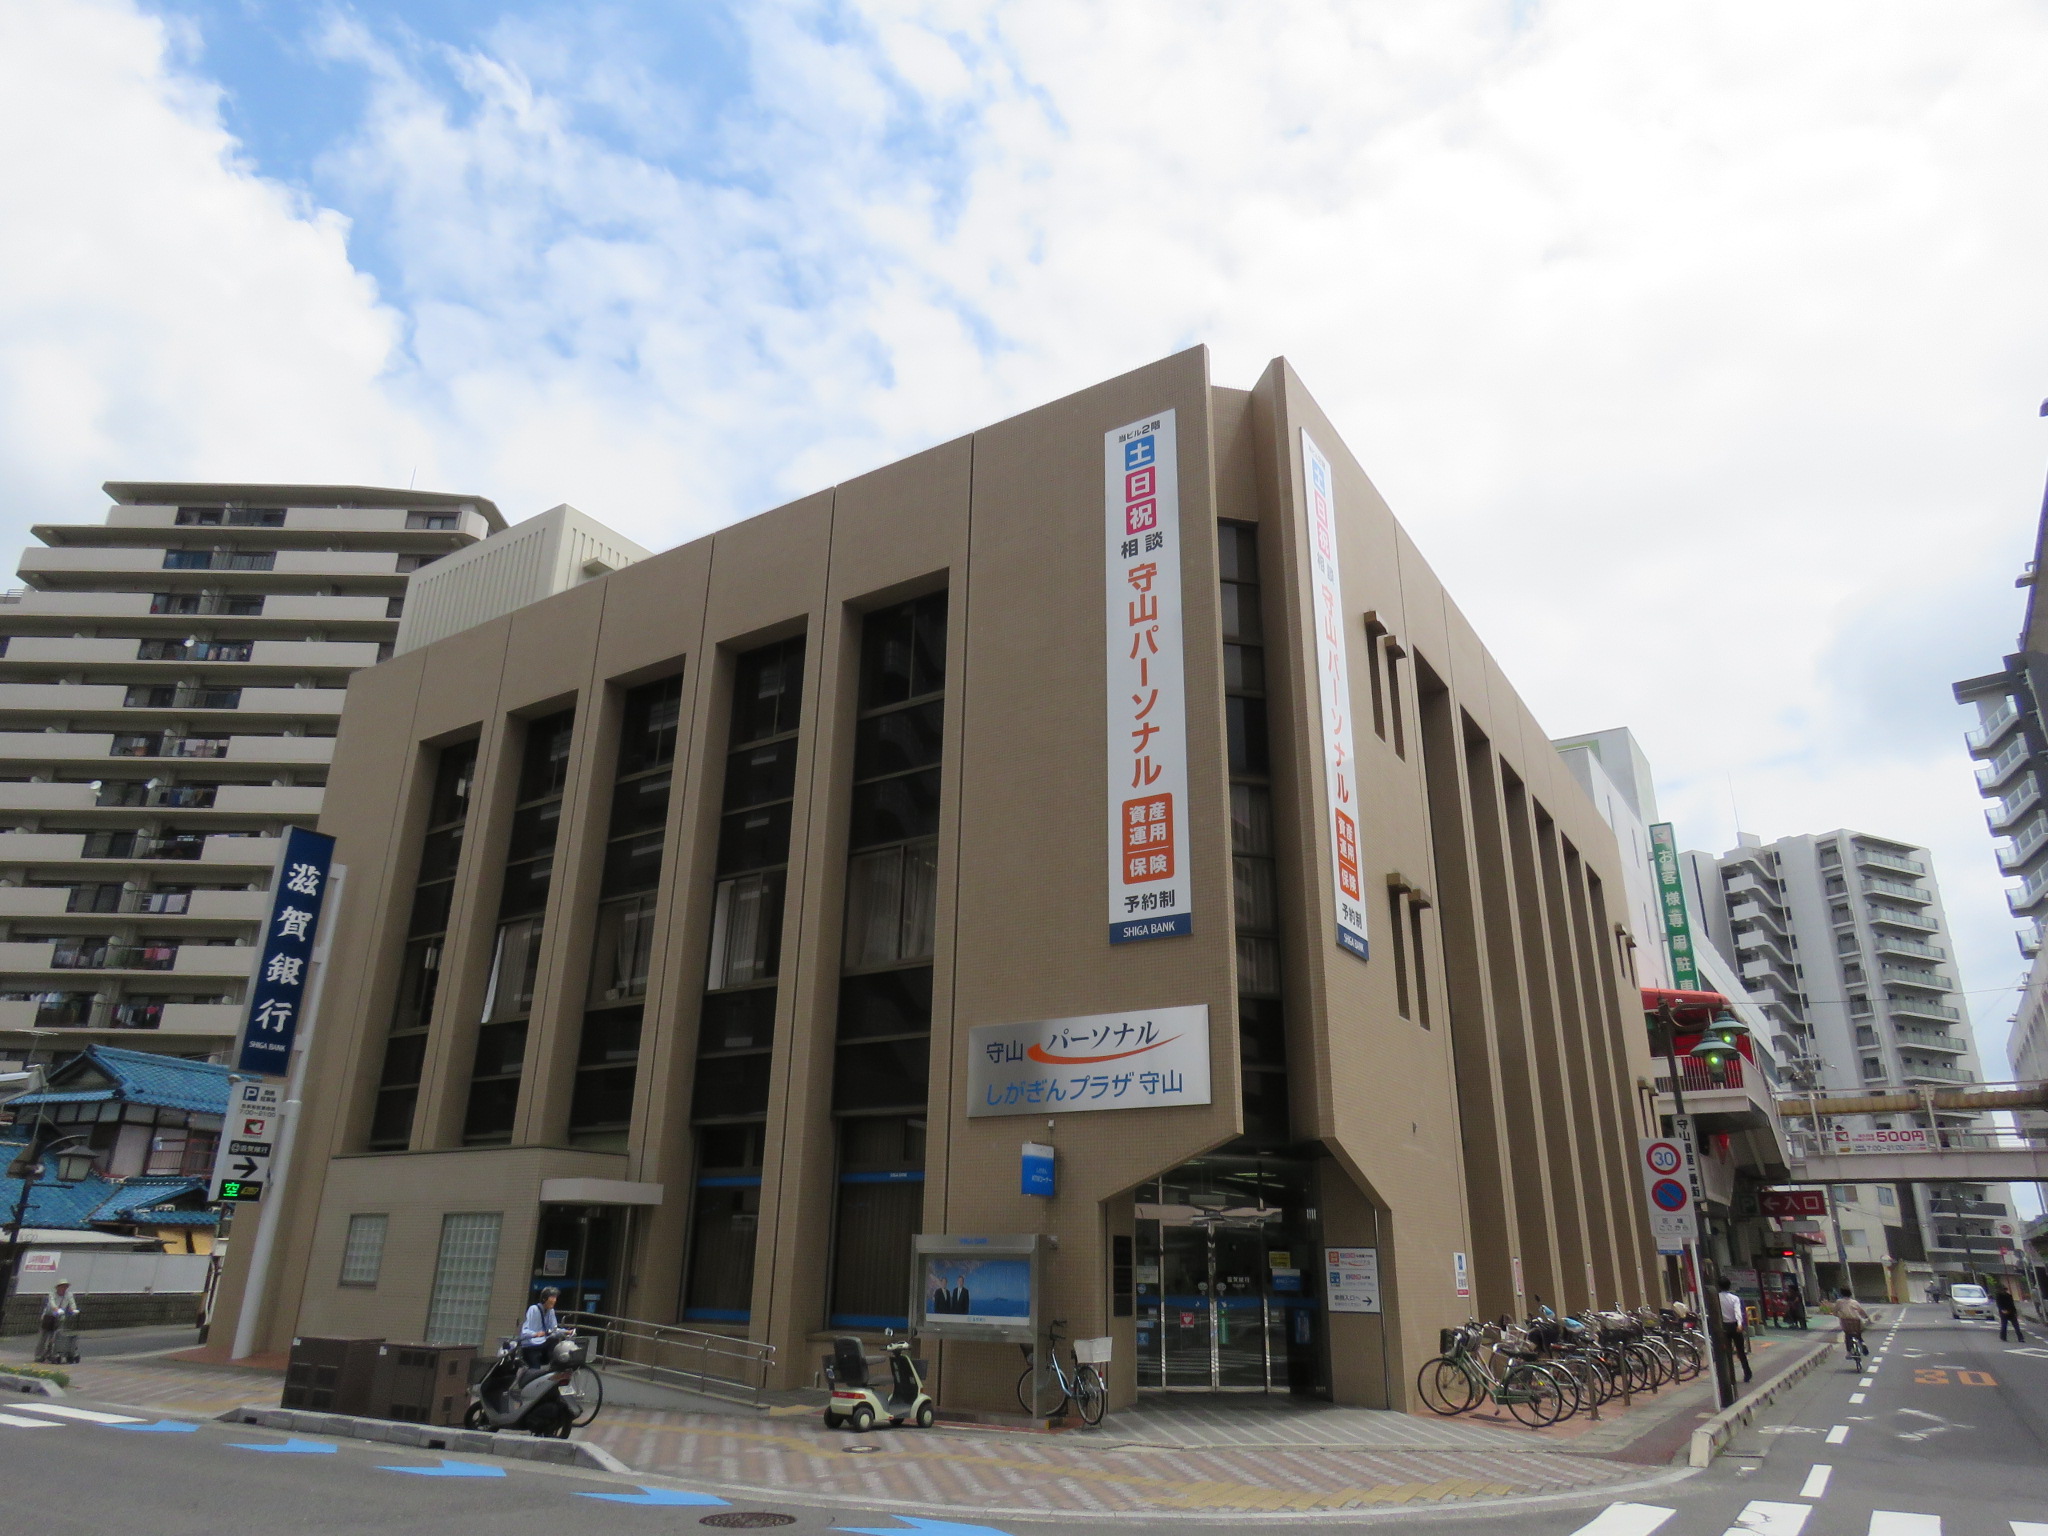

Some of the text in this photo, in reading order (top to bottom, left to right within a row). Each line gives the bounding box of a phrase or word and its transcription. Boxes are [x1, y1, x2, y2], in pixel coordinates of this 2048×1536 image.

[1119, 420, 1161, 442] 当ビル2階
[1121, 531, 1164, 560] 相談
[1128, 562, 1162, 789] 守山パーソナル
[1129, 801, 1166, 825] 資産
[1129, 822, 1167, 846] 運用
[1129, 854, 1168, 878] 保険
[1123, 889, 1175, 914] 予約制
[1123, 920, 1175, 938] SHIGA BANK
[255, 863, 322, 1032] 滋賀銀行
[249, 1040, 286, 1053] SHIGA BANK
[986, 1021, 1160, 1064] 守山 パーソナル
[245, 1088, 258, 1100] P
[986, 1069, 1183, 1106] しがぎんプラザ守山
[1876, 1130, 1924, 1142] 500円
[1654, 1151, 1675, 1167] 30
[223, 1182, 240, 1197] 空
[1784, 1196, 1820, 1210] 入口
[1914, 1369, 1998, 1386] 30
